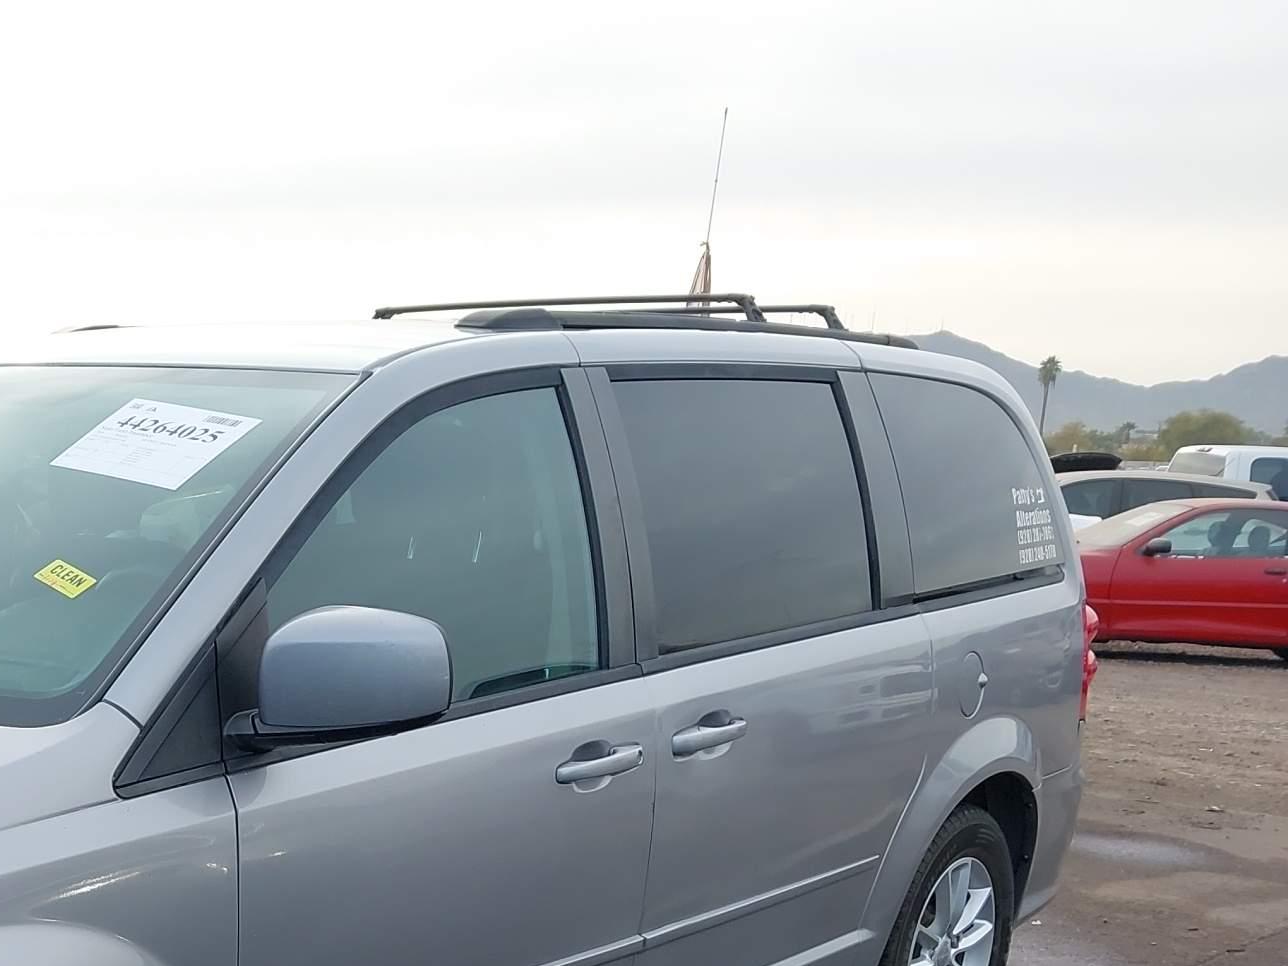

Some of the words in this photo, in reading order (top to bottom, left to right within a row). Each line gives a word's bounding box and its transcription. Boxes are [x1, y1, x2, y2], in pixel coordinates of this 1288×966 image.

[117, 416, 225, 444] 44264025
[1016, 508, 1051, 527] Alterations
[50, 564, 88, 588] CLEAN
